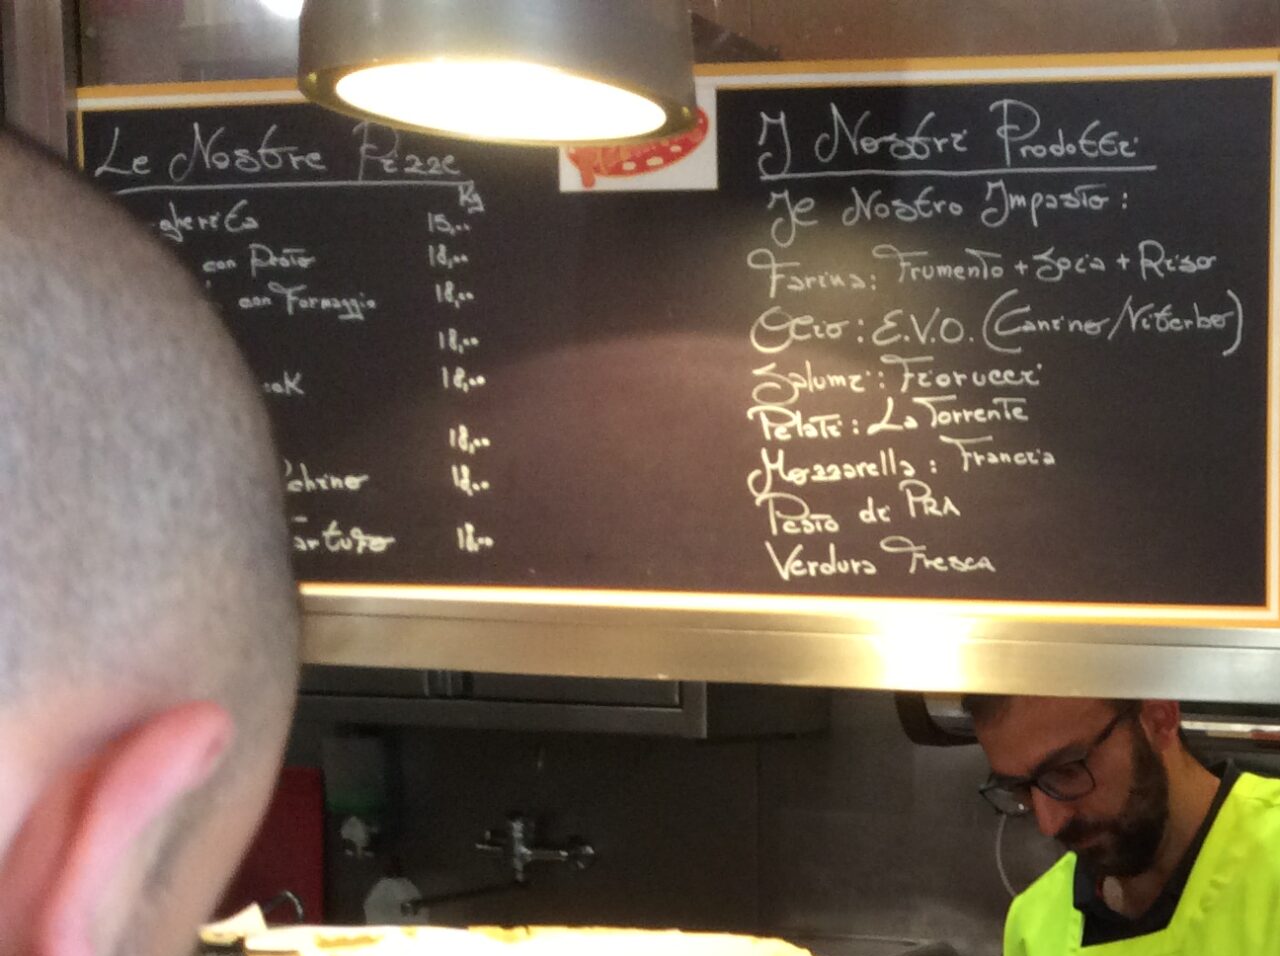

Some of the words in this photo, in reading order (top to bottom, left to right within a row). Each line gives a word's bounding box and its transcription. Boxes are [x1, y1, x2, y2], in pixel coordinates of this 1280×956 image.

[95, 127, 150, 177] Le
[170, 122, 327, 182] Nostre
[815, 102, 967, 162] Nostri
[990, 98, 1138, 167] Prodotti
[842, 186, 963, 227] Nostro
[872, 244, 1003, 284] Frumento
[1138, 240, 1217, 281] Riso
[873, 307, 975, 347] E.V.O.
[880, 354, 1043, 393] Fiorucci
[867, 396, 919, 435] La
[912, 394, 1029, 428] Torrente
[939, 434, 1056, 472] Francia
[755, 492, 840, 536] Pesto
[859, 496, 891, 524] di
[293, 516, 396, 554] artufo
[765, 540, 877, 581] Verdura
[879, 535, 997, 574] Fresca
